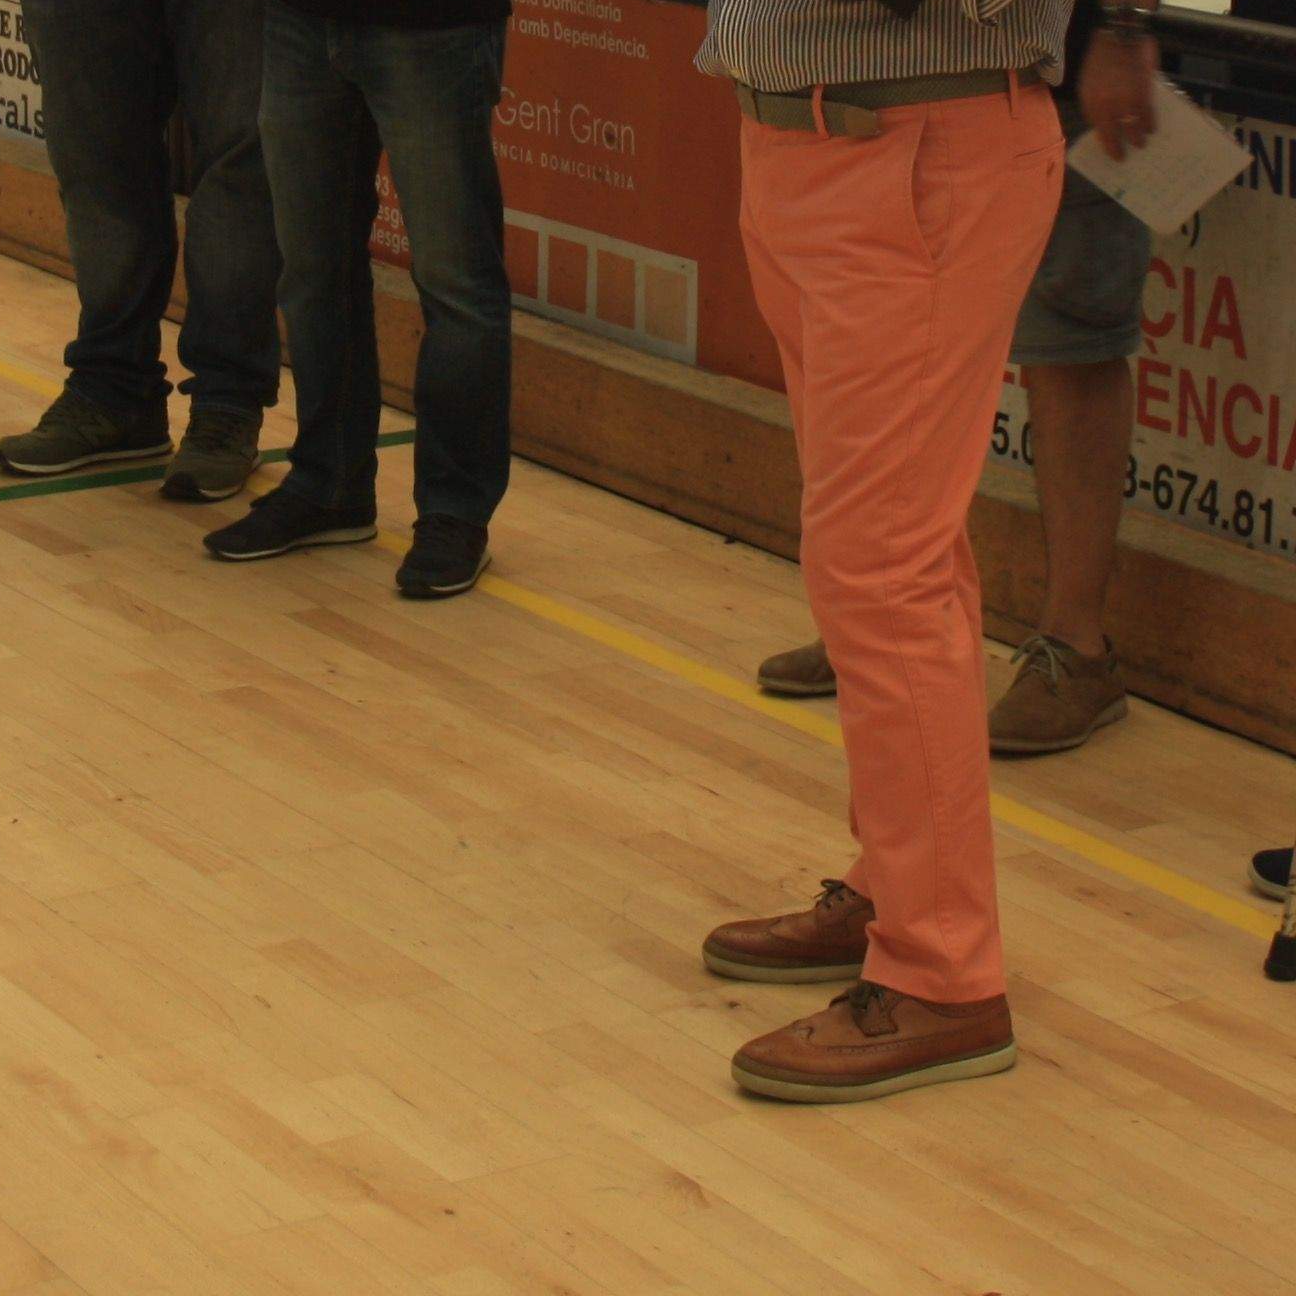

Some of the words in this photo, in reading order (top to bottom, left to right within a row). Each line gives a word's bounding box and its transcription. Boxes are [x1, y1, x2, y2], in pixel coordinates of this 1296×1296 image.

[519, 19, 550, 38] amb
[495, 85, 561, 137] Gent
[570, 102, 636, 156] Gran
